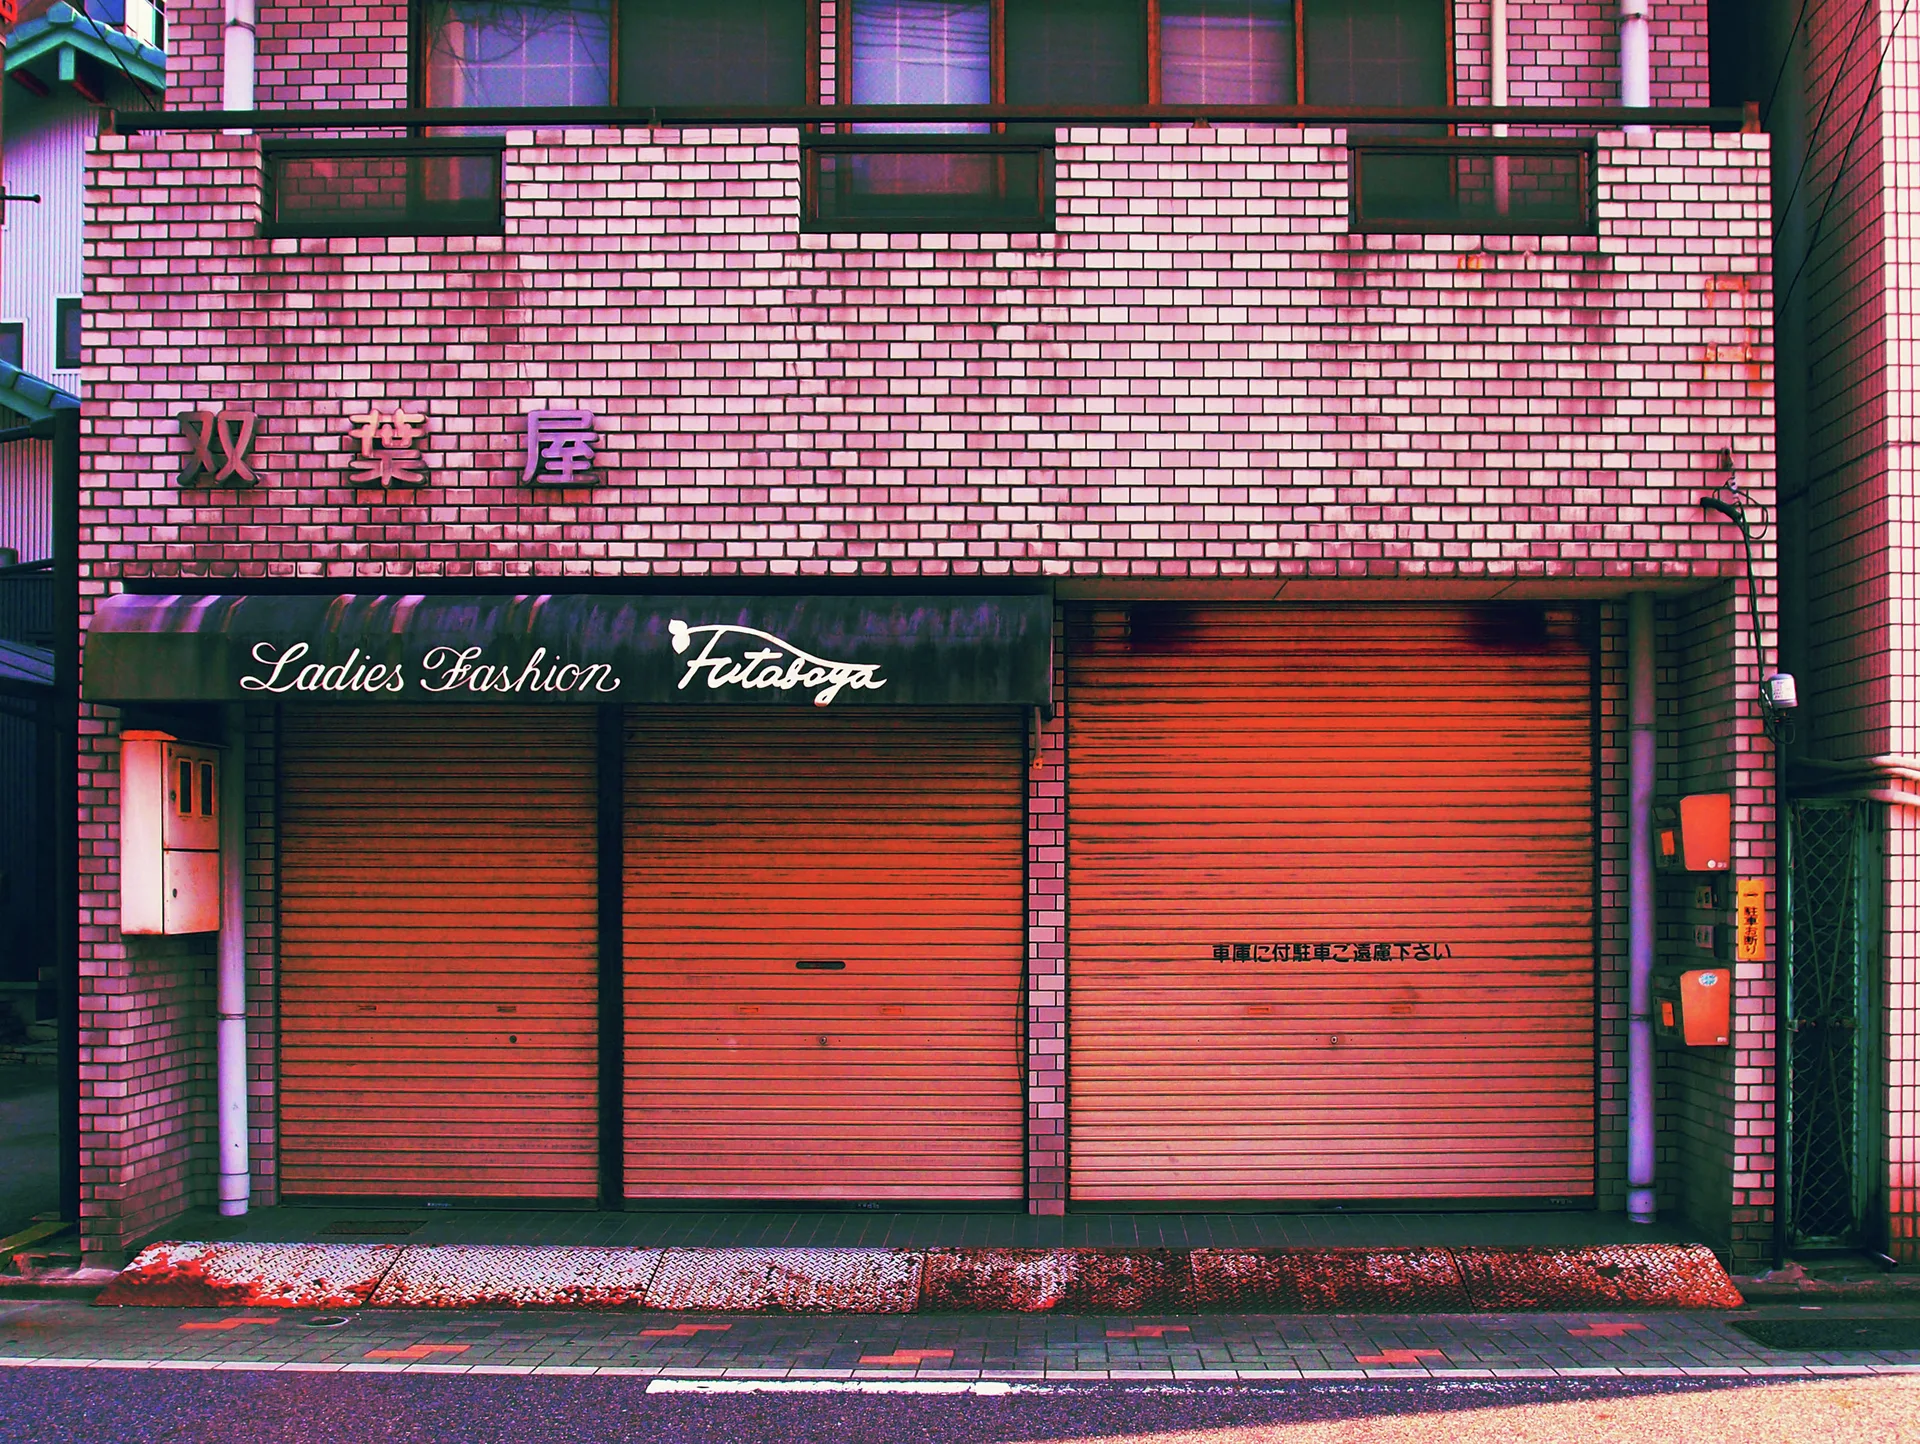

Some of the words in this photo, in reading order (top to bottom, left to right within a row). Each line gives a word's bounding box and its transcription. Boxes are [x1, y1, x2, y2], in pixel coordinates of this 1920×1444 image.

[177, 408, 600, 488] 双葉屋
[237, 642, 404, 692] Ladies
[419, 645, 621, 692] Fashion
